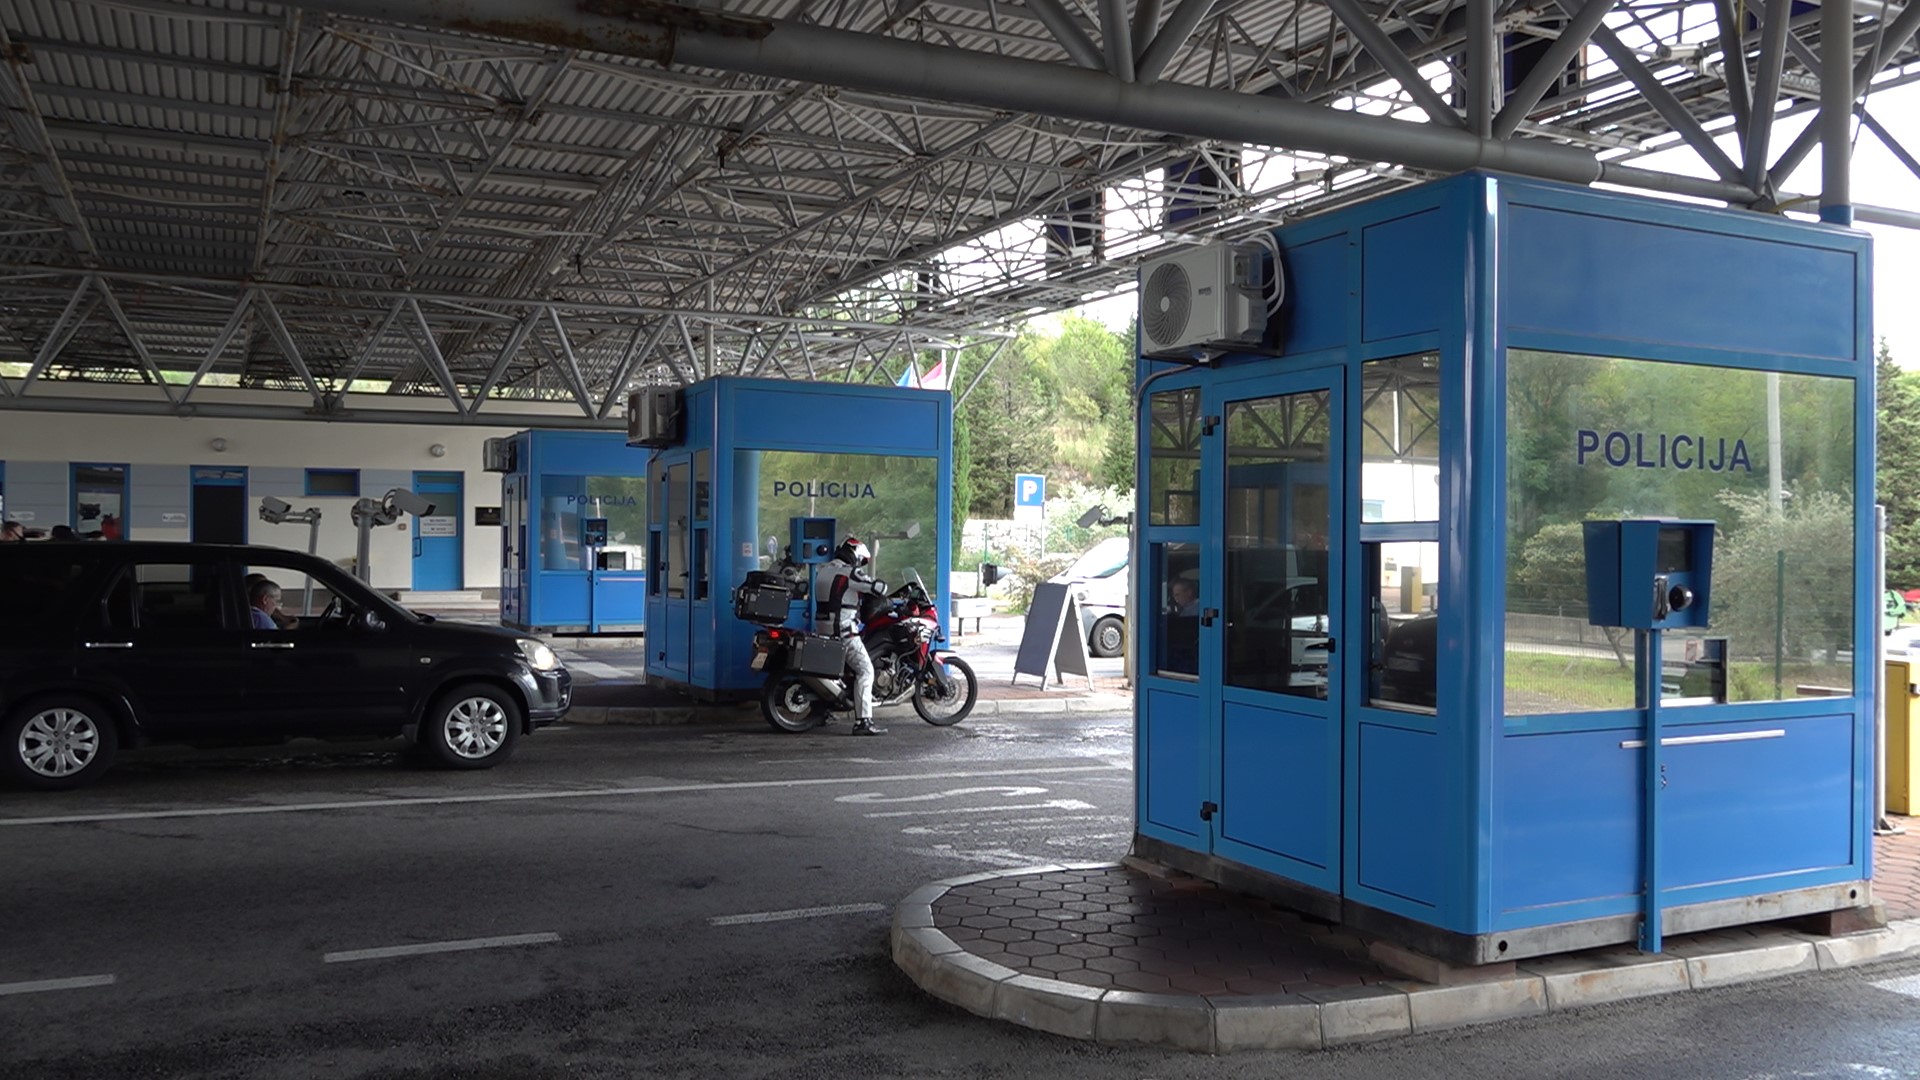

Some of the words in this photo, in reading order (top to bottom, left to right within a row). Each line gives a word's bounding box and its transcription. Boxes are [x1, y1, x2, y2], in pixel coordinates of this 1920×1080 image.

[1577, 430, 1752, 472] POLICIJA
[567, 494, 637, 506] POLICIJA
[774, 481, 876, 499] POLICIJA
[1023, 480, 1038, 502] P
